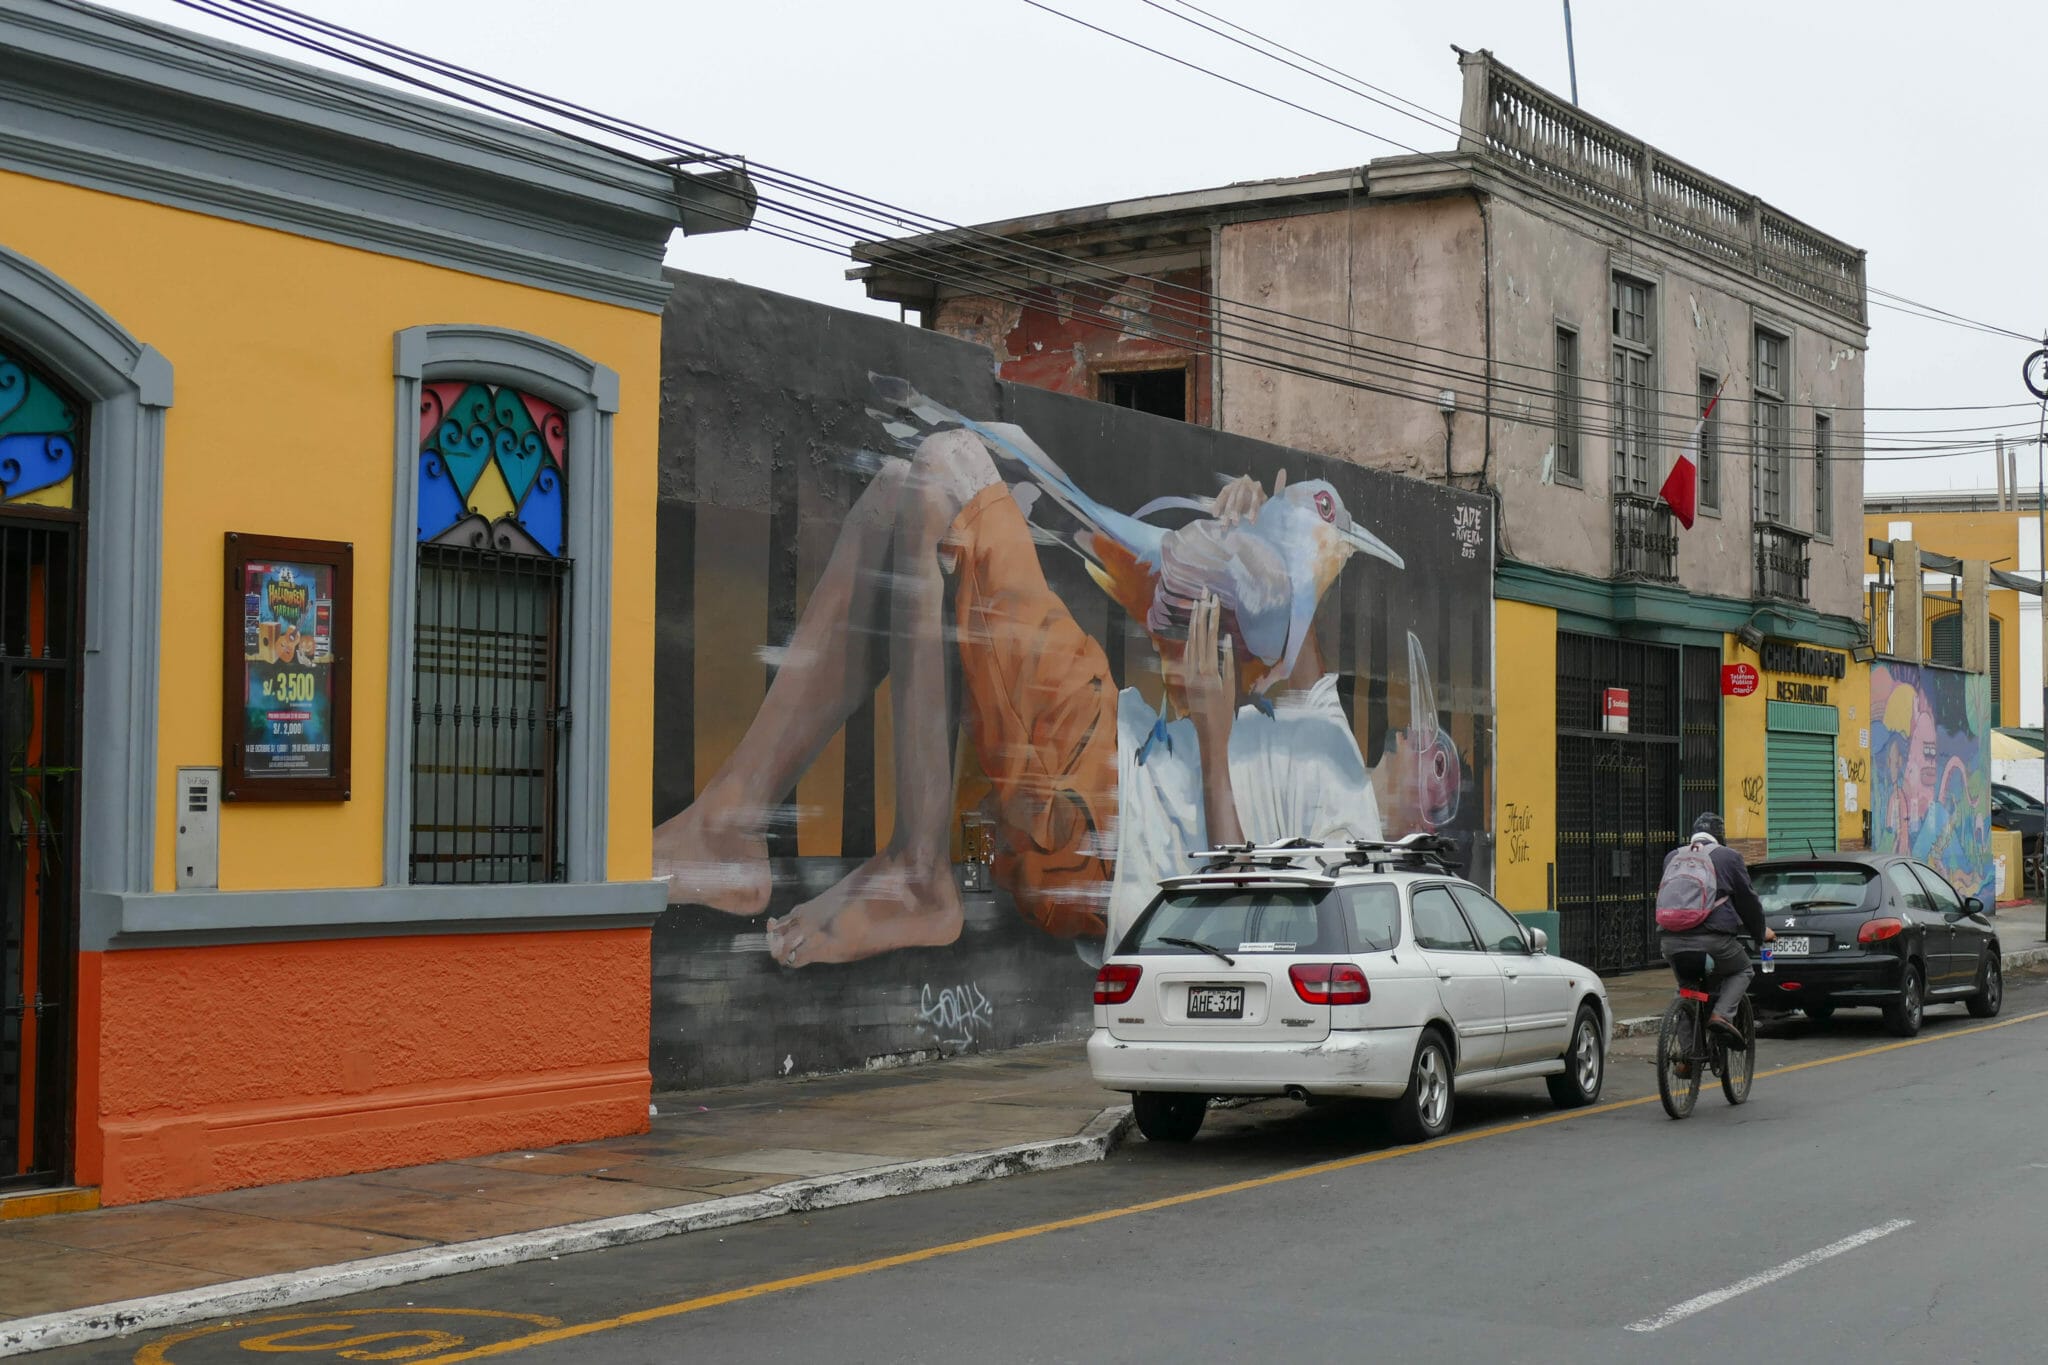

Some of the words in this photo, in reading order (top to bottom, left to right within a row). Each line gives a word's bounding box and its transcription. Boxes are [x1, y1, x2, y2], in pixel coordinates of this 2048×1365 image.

[1461, 548, 1476, 559] 2015
[268, 584, 306, 609] HALLOWEEN
[1765, 643, 1797, 674] CHIFA
[1800, 648, 1830, 677] HONG
[1833, 652, 1846, 679] FU
[277, 672, 315, 704] 3,500
[1191, 995, 1240, 1012] AHE-311
